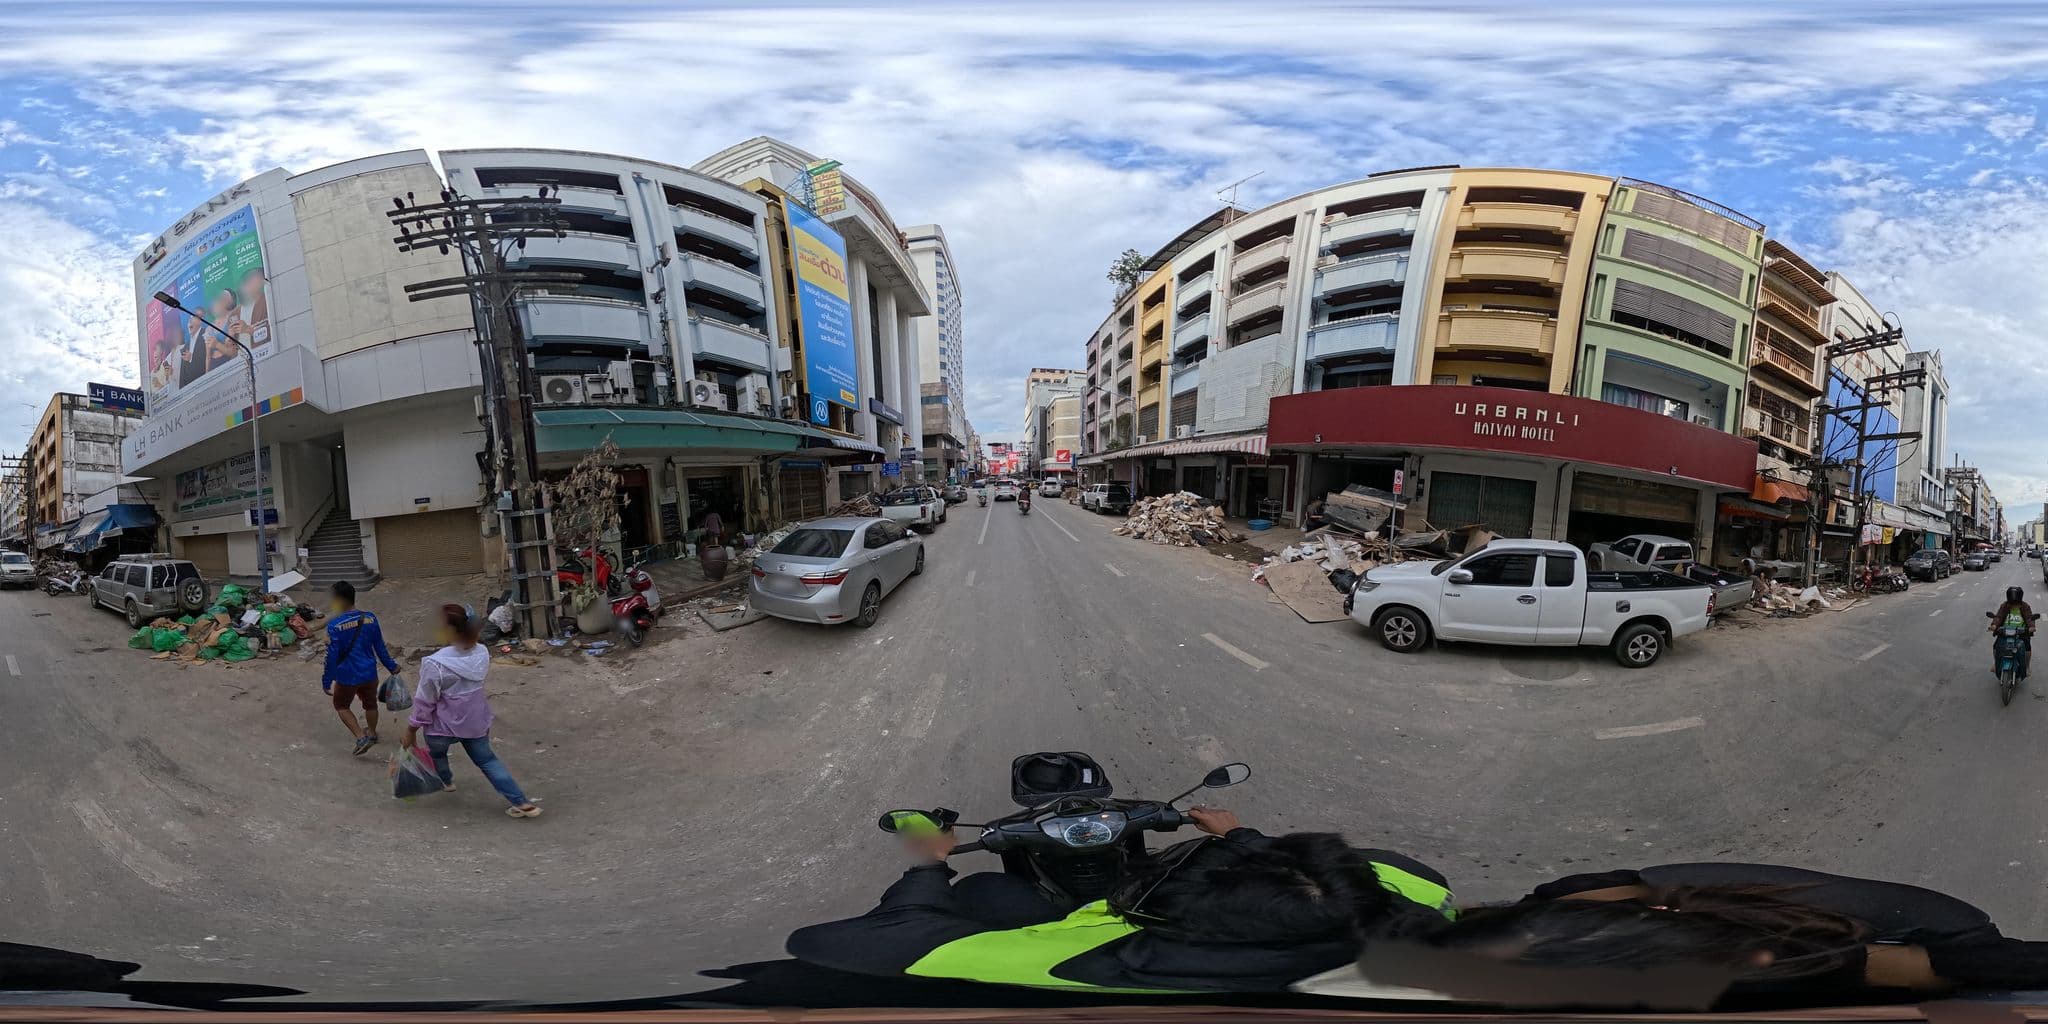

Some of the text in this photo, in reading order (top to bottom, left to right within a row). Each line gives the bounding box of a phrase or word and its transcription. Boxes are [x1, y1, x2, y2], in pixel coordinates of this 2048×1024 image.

[174, 182, 250, 236] BANK
[235, 243, 256, 255] CARE
[203, 255, 228, 274] HEALTH
[89, 387, 104, 398] LH
[110, 390, 144, 404] BANK
[1454, 402, 1579, 426] URBANLI
[134, 415, 183, 452] LH BANK
[1474, 421, 1555, 442] HATYAI HOTEL
